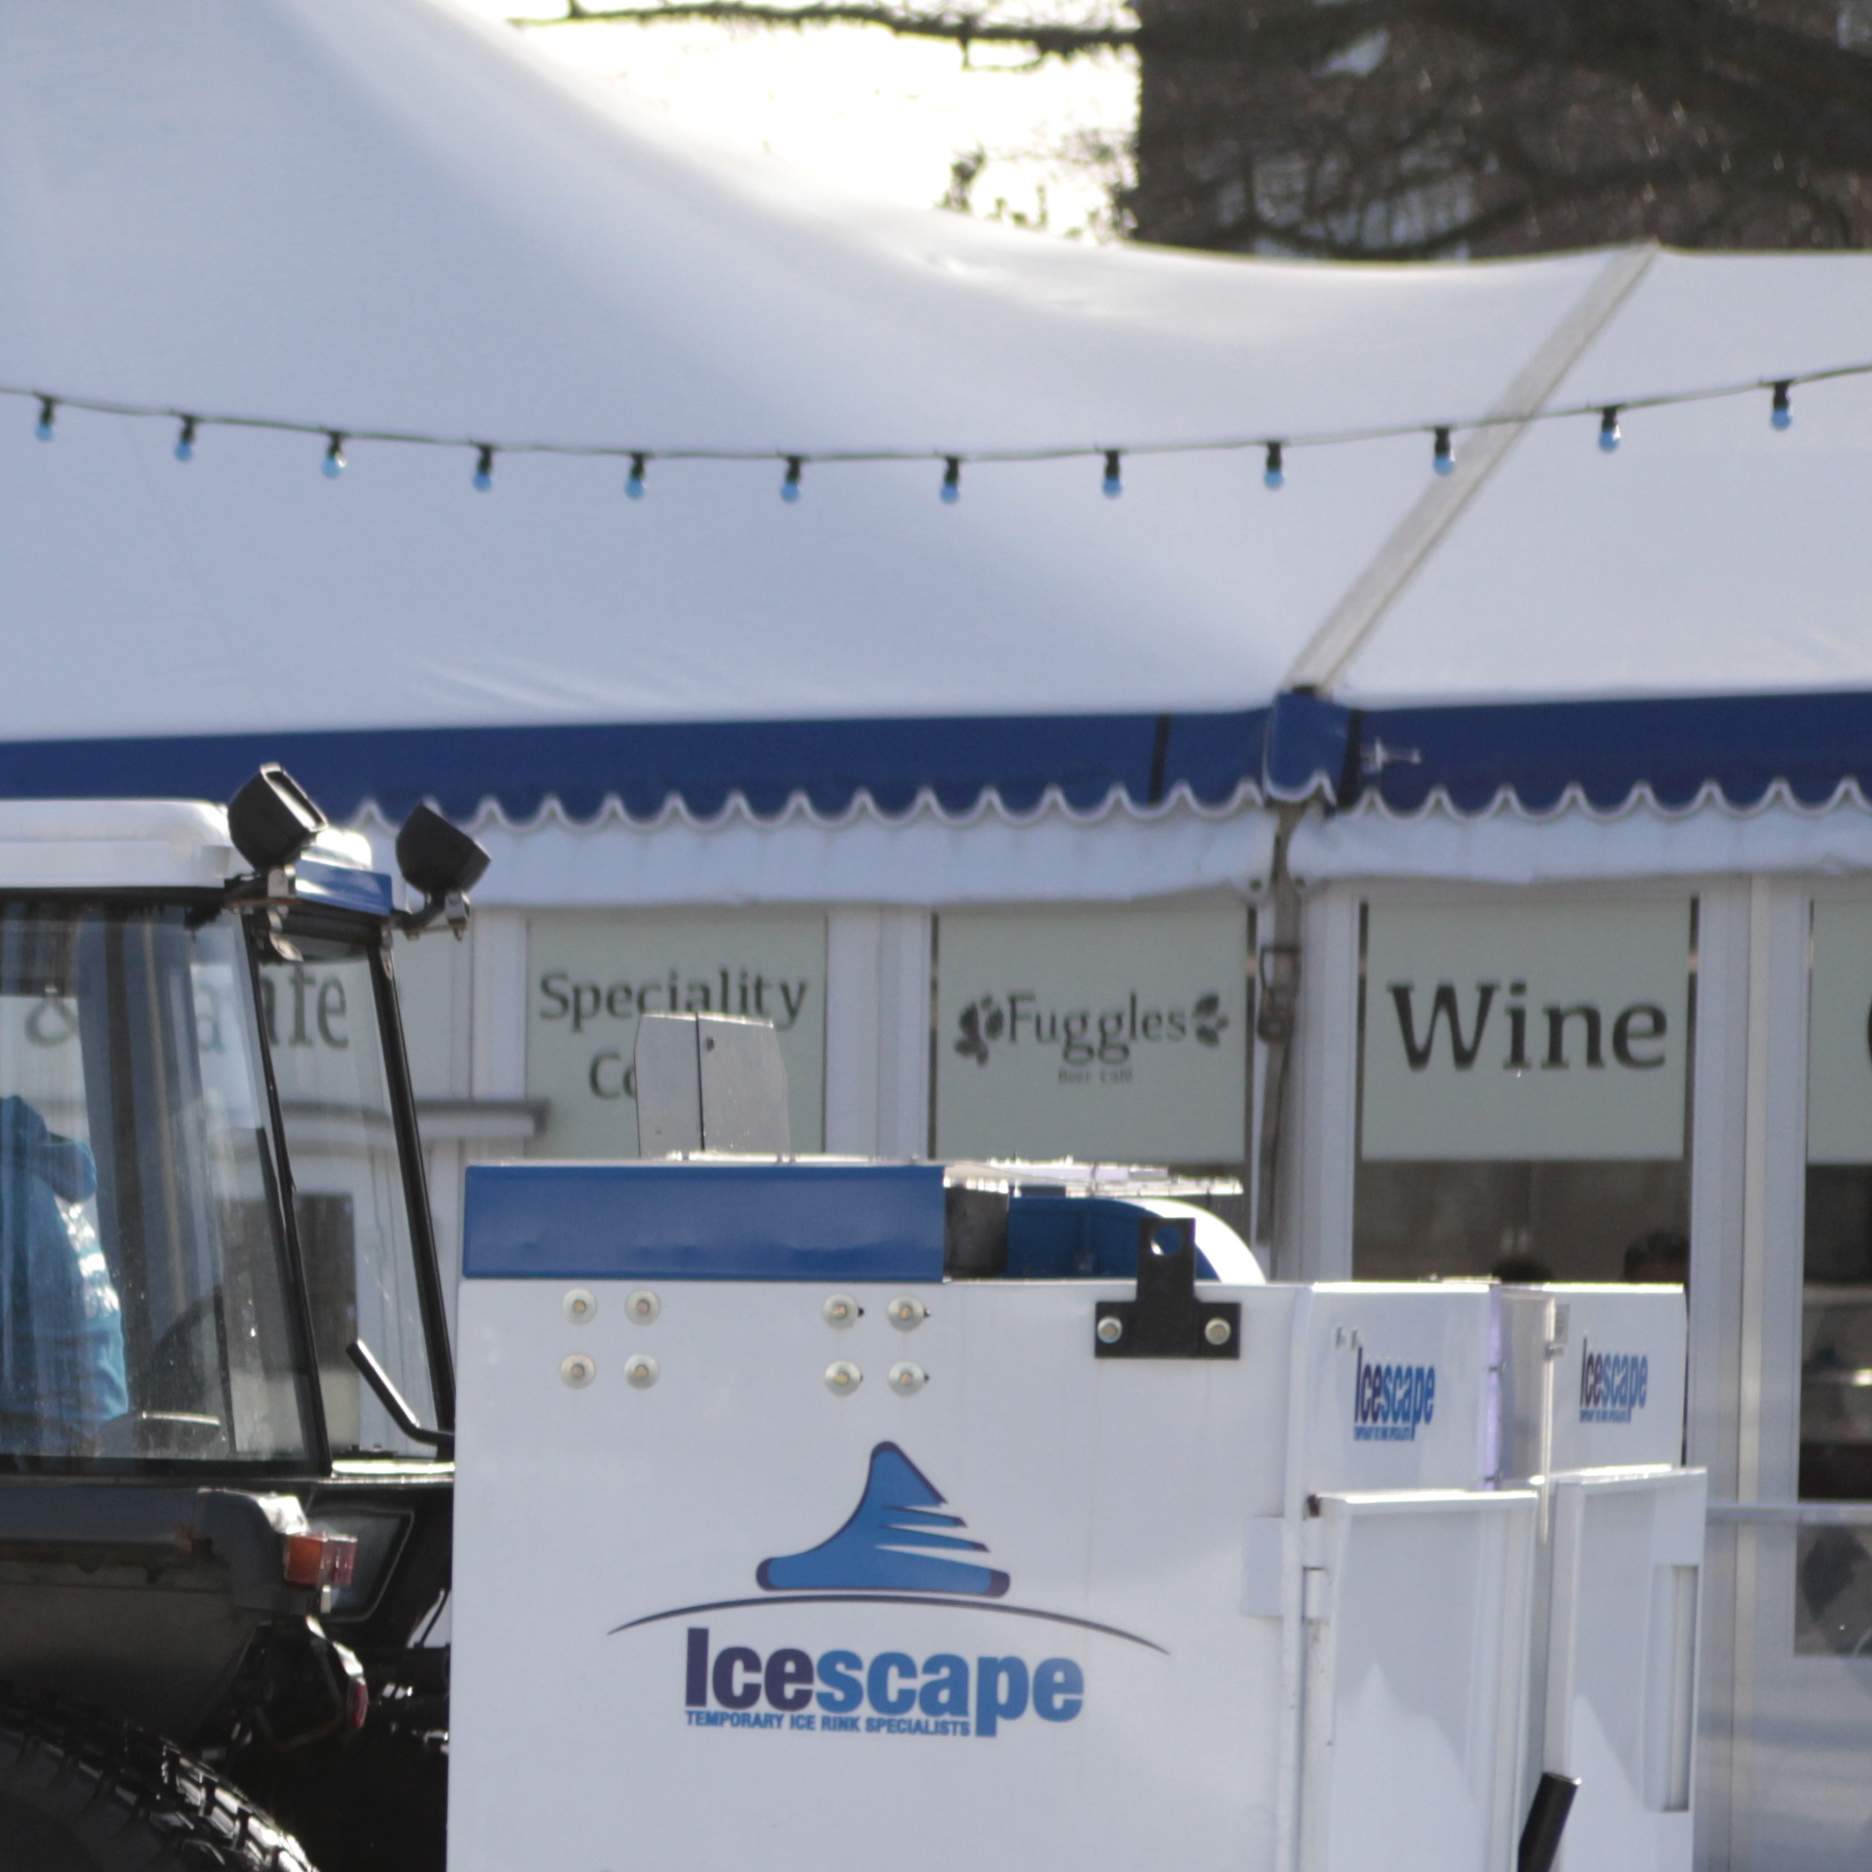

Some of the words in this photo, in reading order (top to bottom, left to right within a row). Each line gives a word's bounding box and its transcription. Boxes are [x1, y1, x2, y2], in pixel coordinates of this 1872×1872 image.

[539, 966, 807, 1034] Speciality
[1006, 989, 1188, 1067] Fuggles
[1387, 979, 1668, 1072] Wine
[1353, 1346, 1436, 1441] Icescape
[1580, 1336, 1649, 1423] Icescape
[684, 1627, 1085, 1738] Icescape
[685, 1710, 784, 1729] TEMPORARY
[789, 1714, 816, 1731] ICE
[820, 1715, 861, 1733] RINK
[865, 1717, 971, 1737] SPECIALISTS
